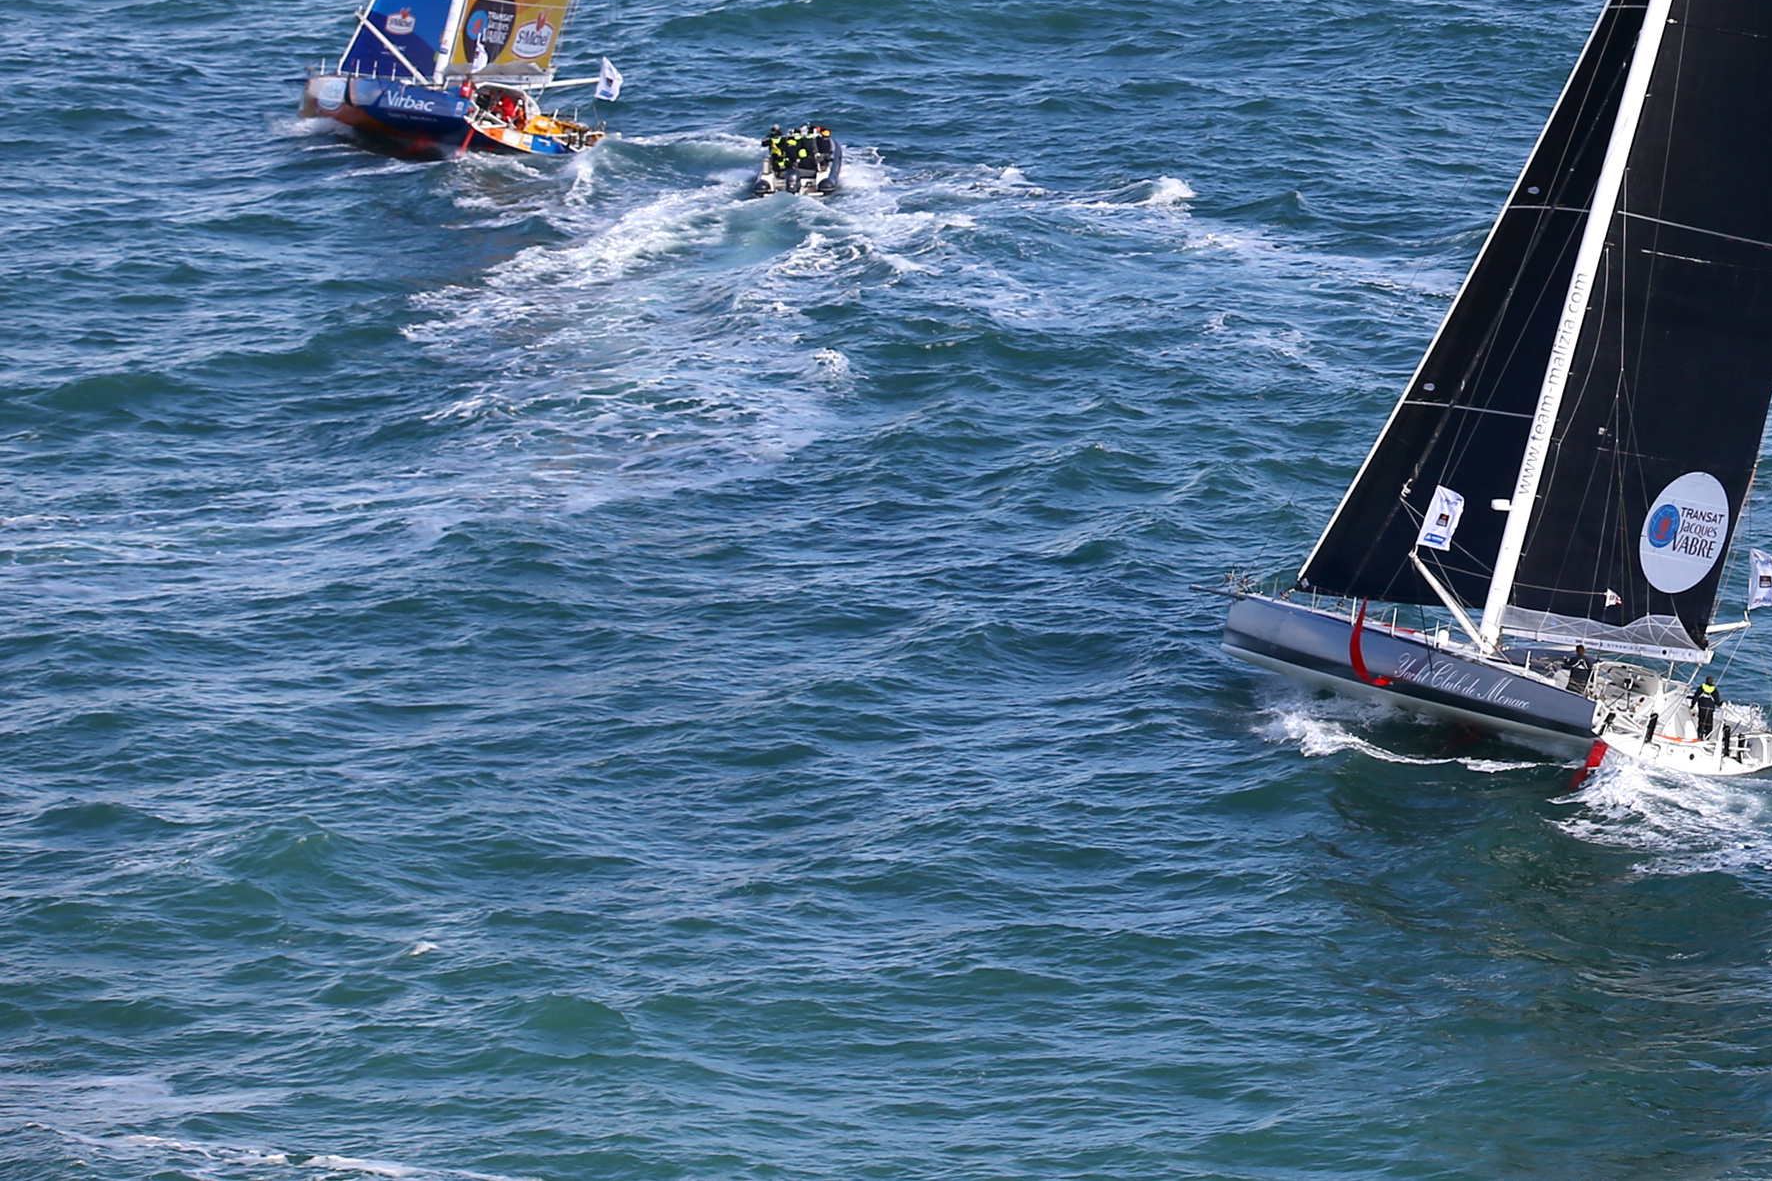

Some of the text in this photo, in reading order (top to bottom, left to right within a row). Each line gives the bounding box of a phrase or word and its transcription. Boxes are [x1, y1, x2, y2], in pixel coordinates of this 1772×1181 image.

[386, 89, 436, 112] Virbac
[1518, 272, 1589, 496] www.team-malizia.com
[1681, 506, 1725, 525] TRANSAT
[1678, 519, 1719, 539] Jacques
[1672, 530, 1717, 559] VABRE
[1394, 652, 1530, 711] Yacht Club de Monaco
